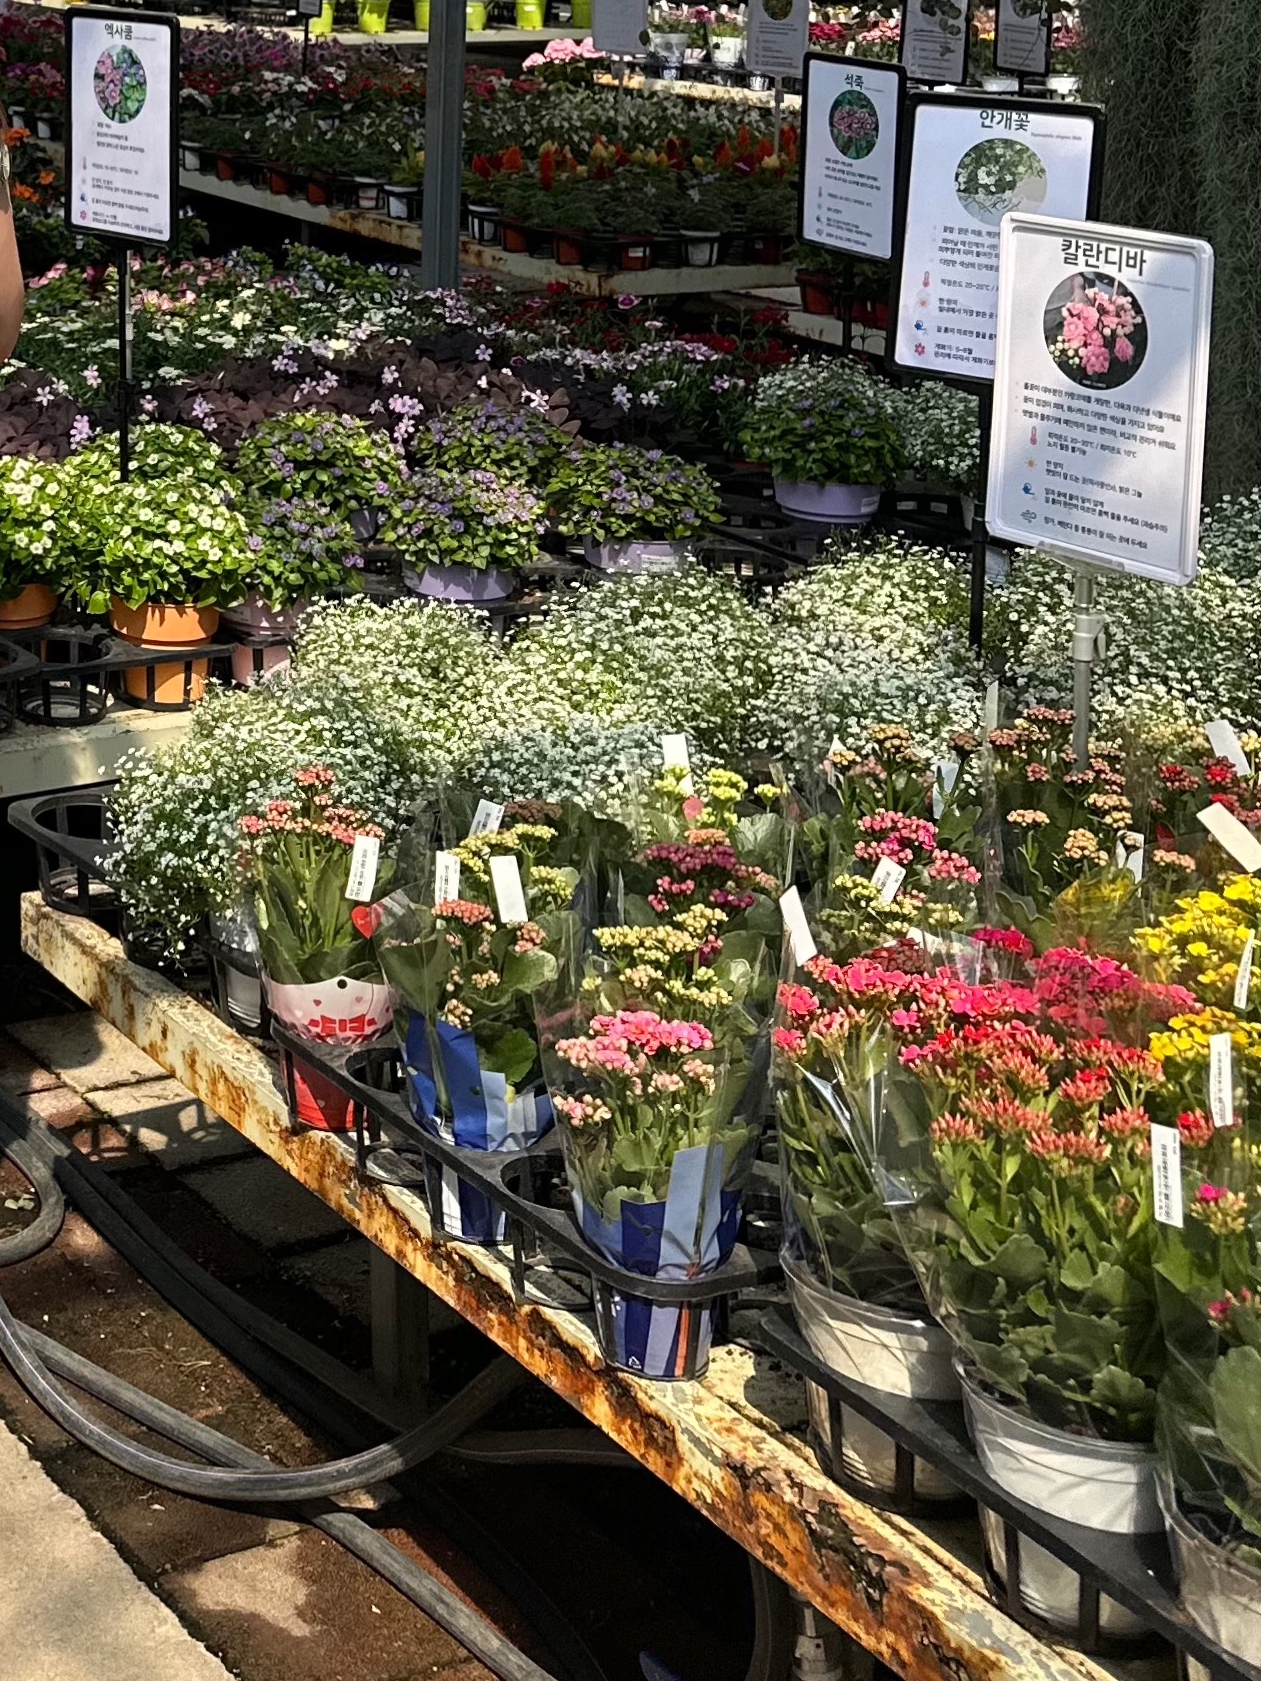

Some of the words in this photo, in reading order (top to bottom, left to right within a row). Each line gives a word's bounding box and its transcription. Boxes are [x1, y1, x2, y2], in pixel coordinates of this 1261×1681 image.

[844, 73, 865, 90] 석죽
[979, 110, 1030, 132] 안개꽃
[1061, 239, 1147, 276] 칼란디바
